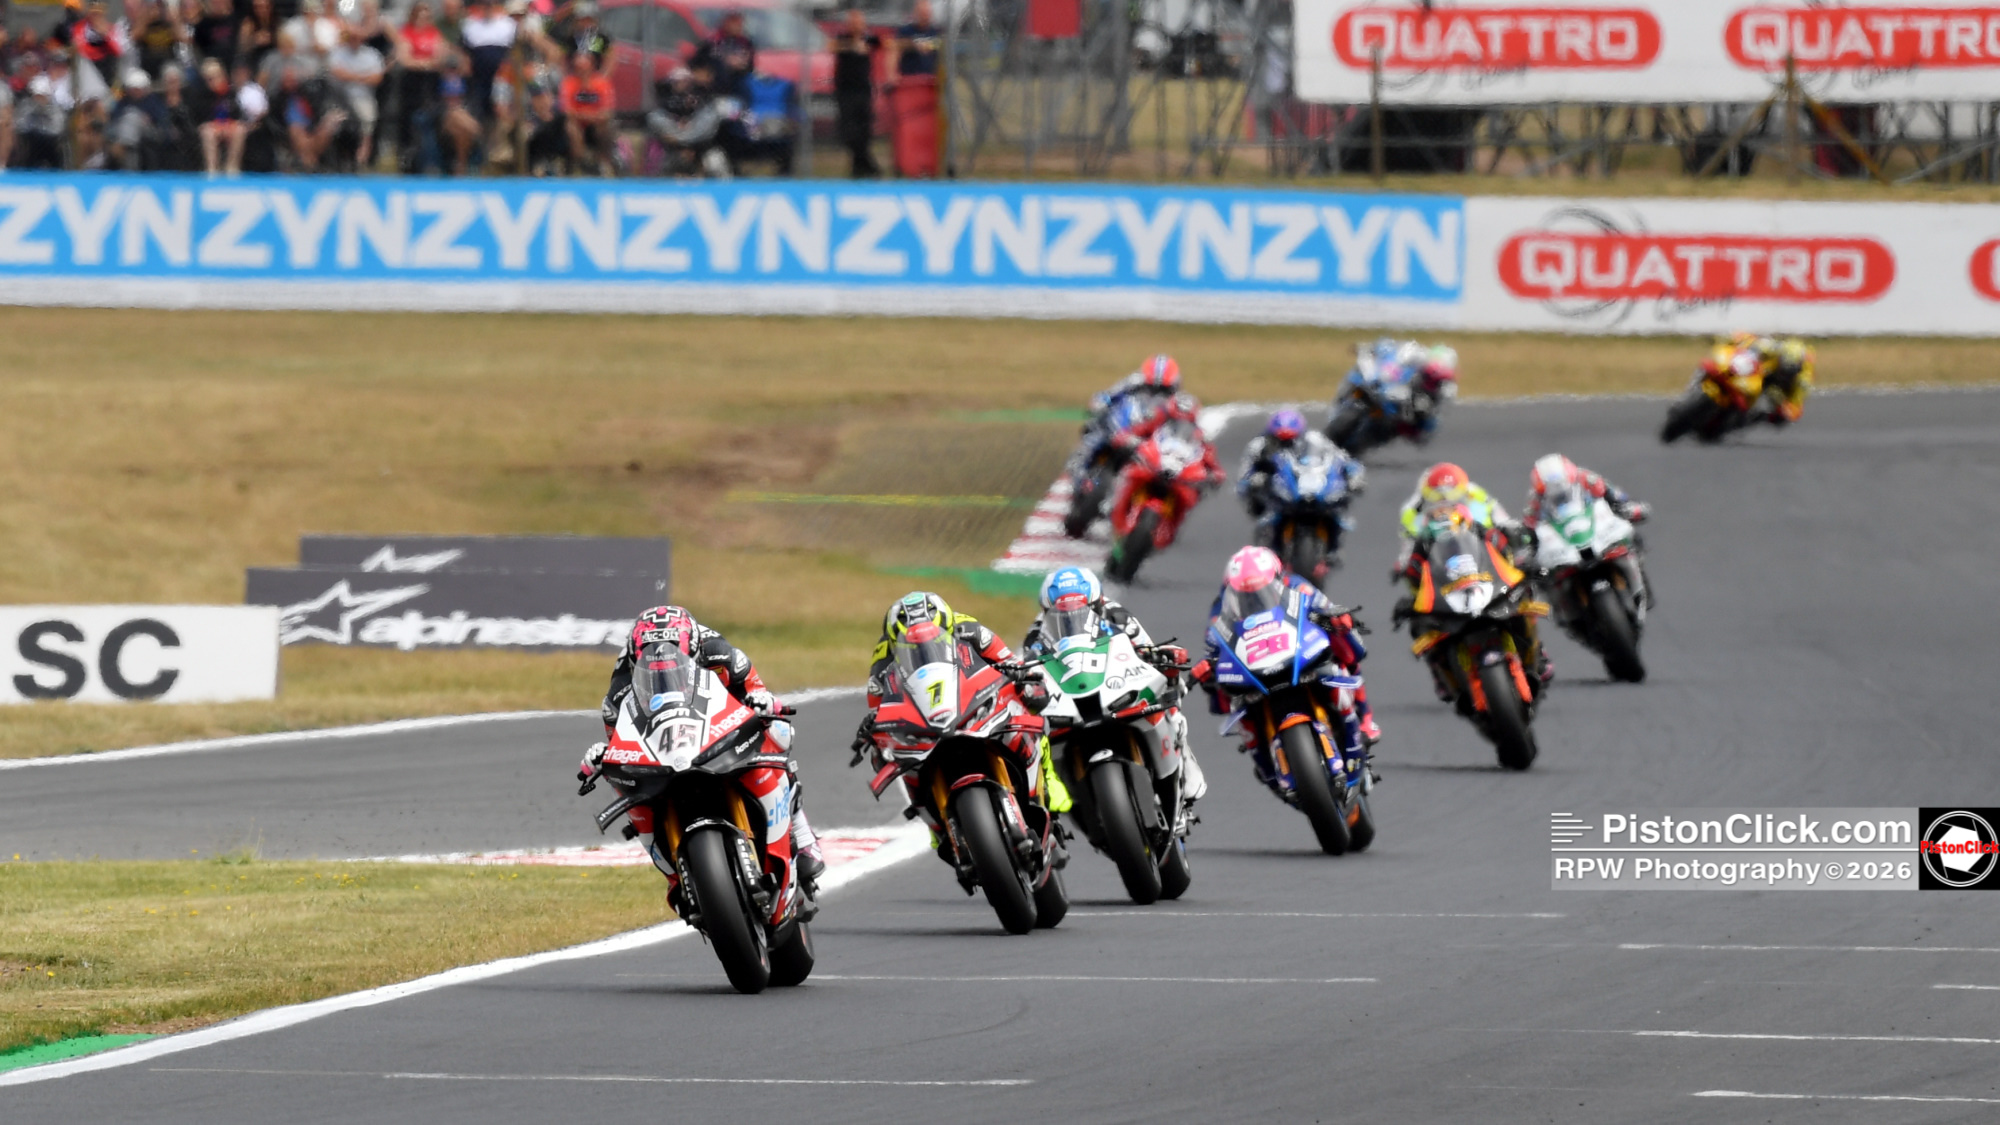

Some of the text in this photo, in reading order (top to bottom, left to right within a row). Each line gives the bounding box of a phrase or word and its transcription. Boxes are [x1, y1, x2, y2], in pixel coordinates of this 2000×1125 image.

[1350, 14, 1640, 65] QUATTRO
[1519, 239, 1868, 297] QUATTRO
[13, 618, 182, 701] SC
[1060, 651, 1107, 684] 30
[926, 680, 945, 709] 1
[658, 723, 698, 755] 45
